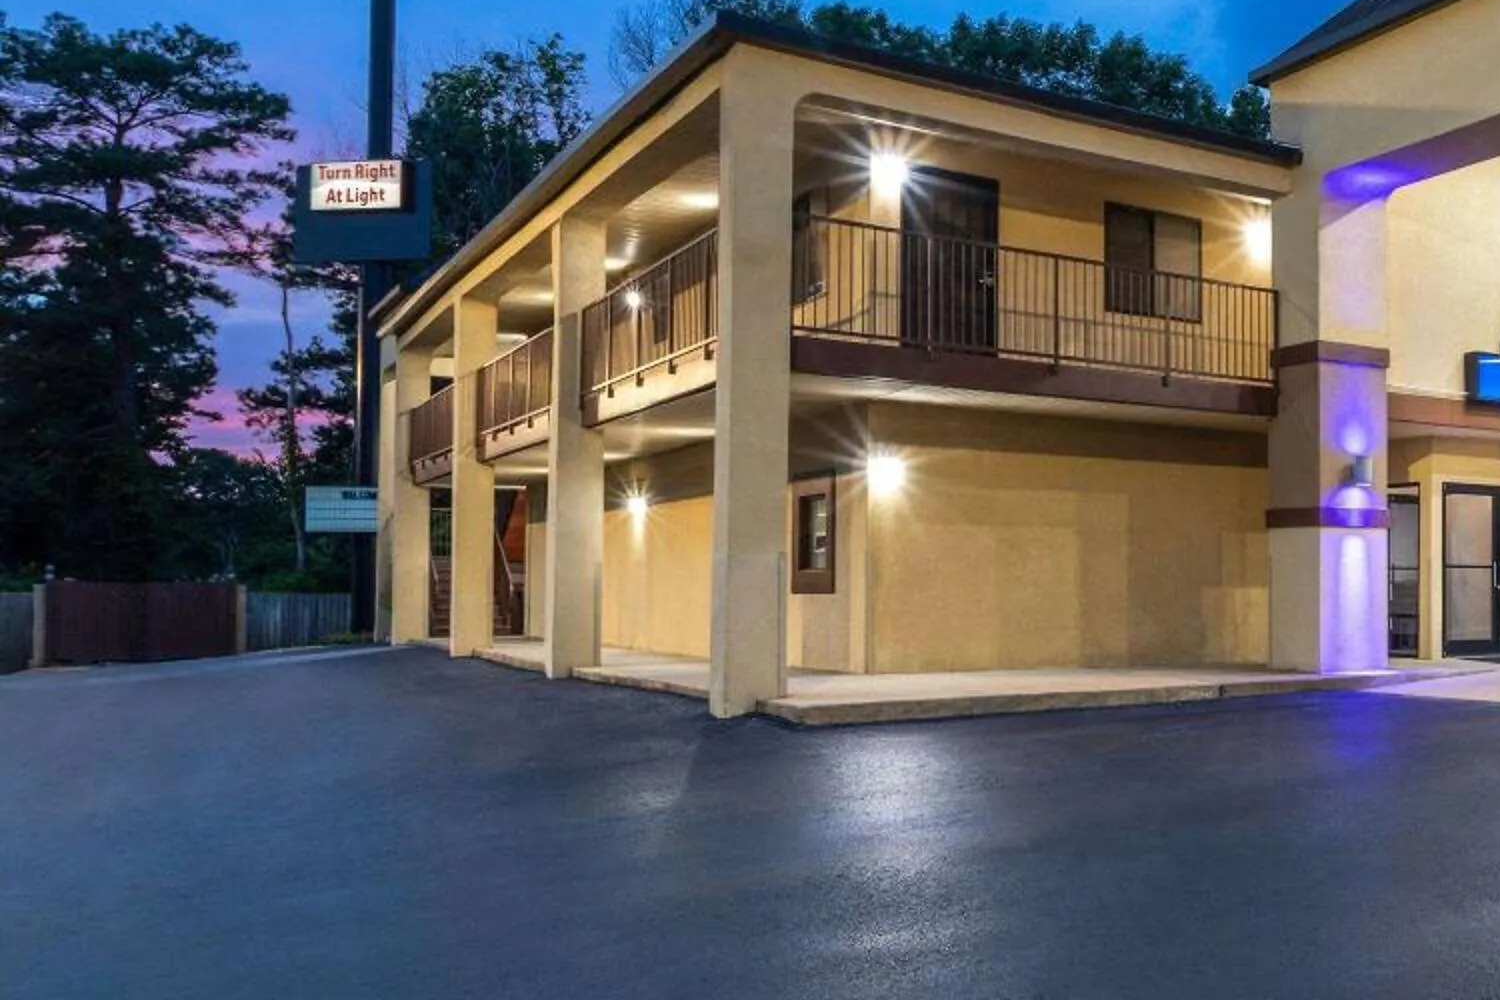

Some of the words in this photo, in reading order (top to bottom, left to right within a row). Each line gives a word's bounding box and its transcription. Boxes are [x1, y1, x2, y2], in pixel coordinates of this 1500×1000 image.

[318, 165, 352, 181] Turn
[354, 163, 397, 183] Right
[325, 188, 343, 204] At
[346, 187, 386, 207] Light
